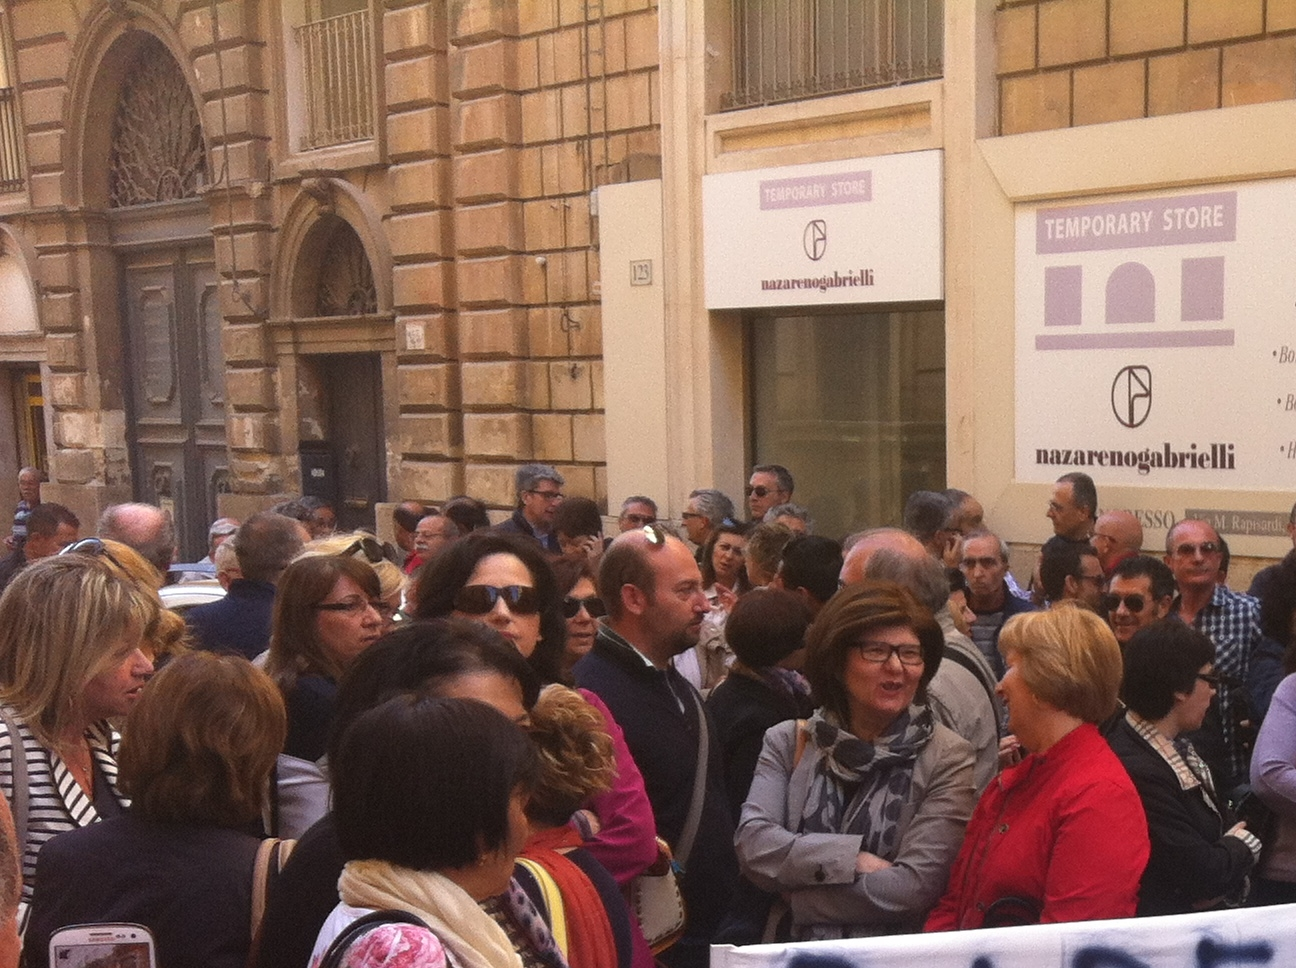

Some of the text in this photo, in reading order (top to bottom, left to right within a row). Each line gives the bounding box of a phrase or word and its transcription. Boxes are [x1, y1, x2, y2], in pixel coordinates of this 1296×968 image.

[764, 179, 866, 203] TEMPORARY STORE
[1045, 204, 1224, 240] TEMPORARY STORE
[633, 263, 649, 281] 123
[761, 269, 874, 293] nazarenogabrielli
[1036, 443, 1235, 475] nazarenogabrielli
